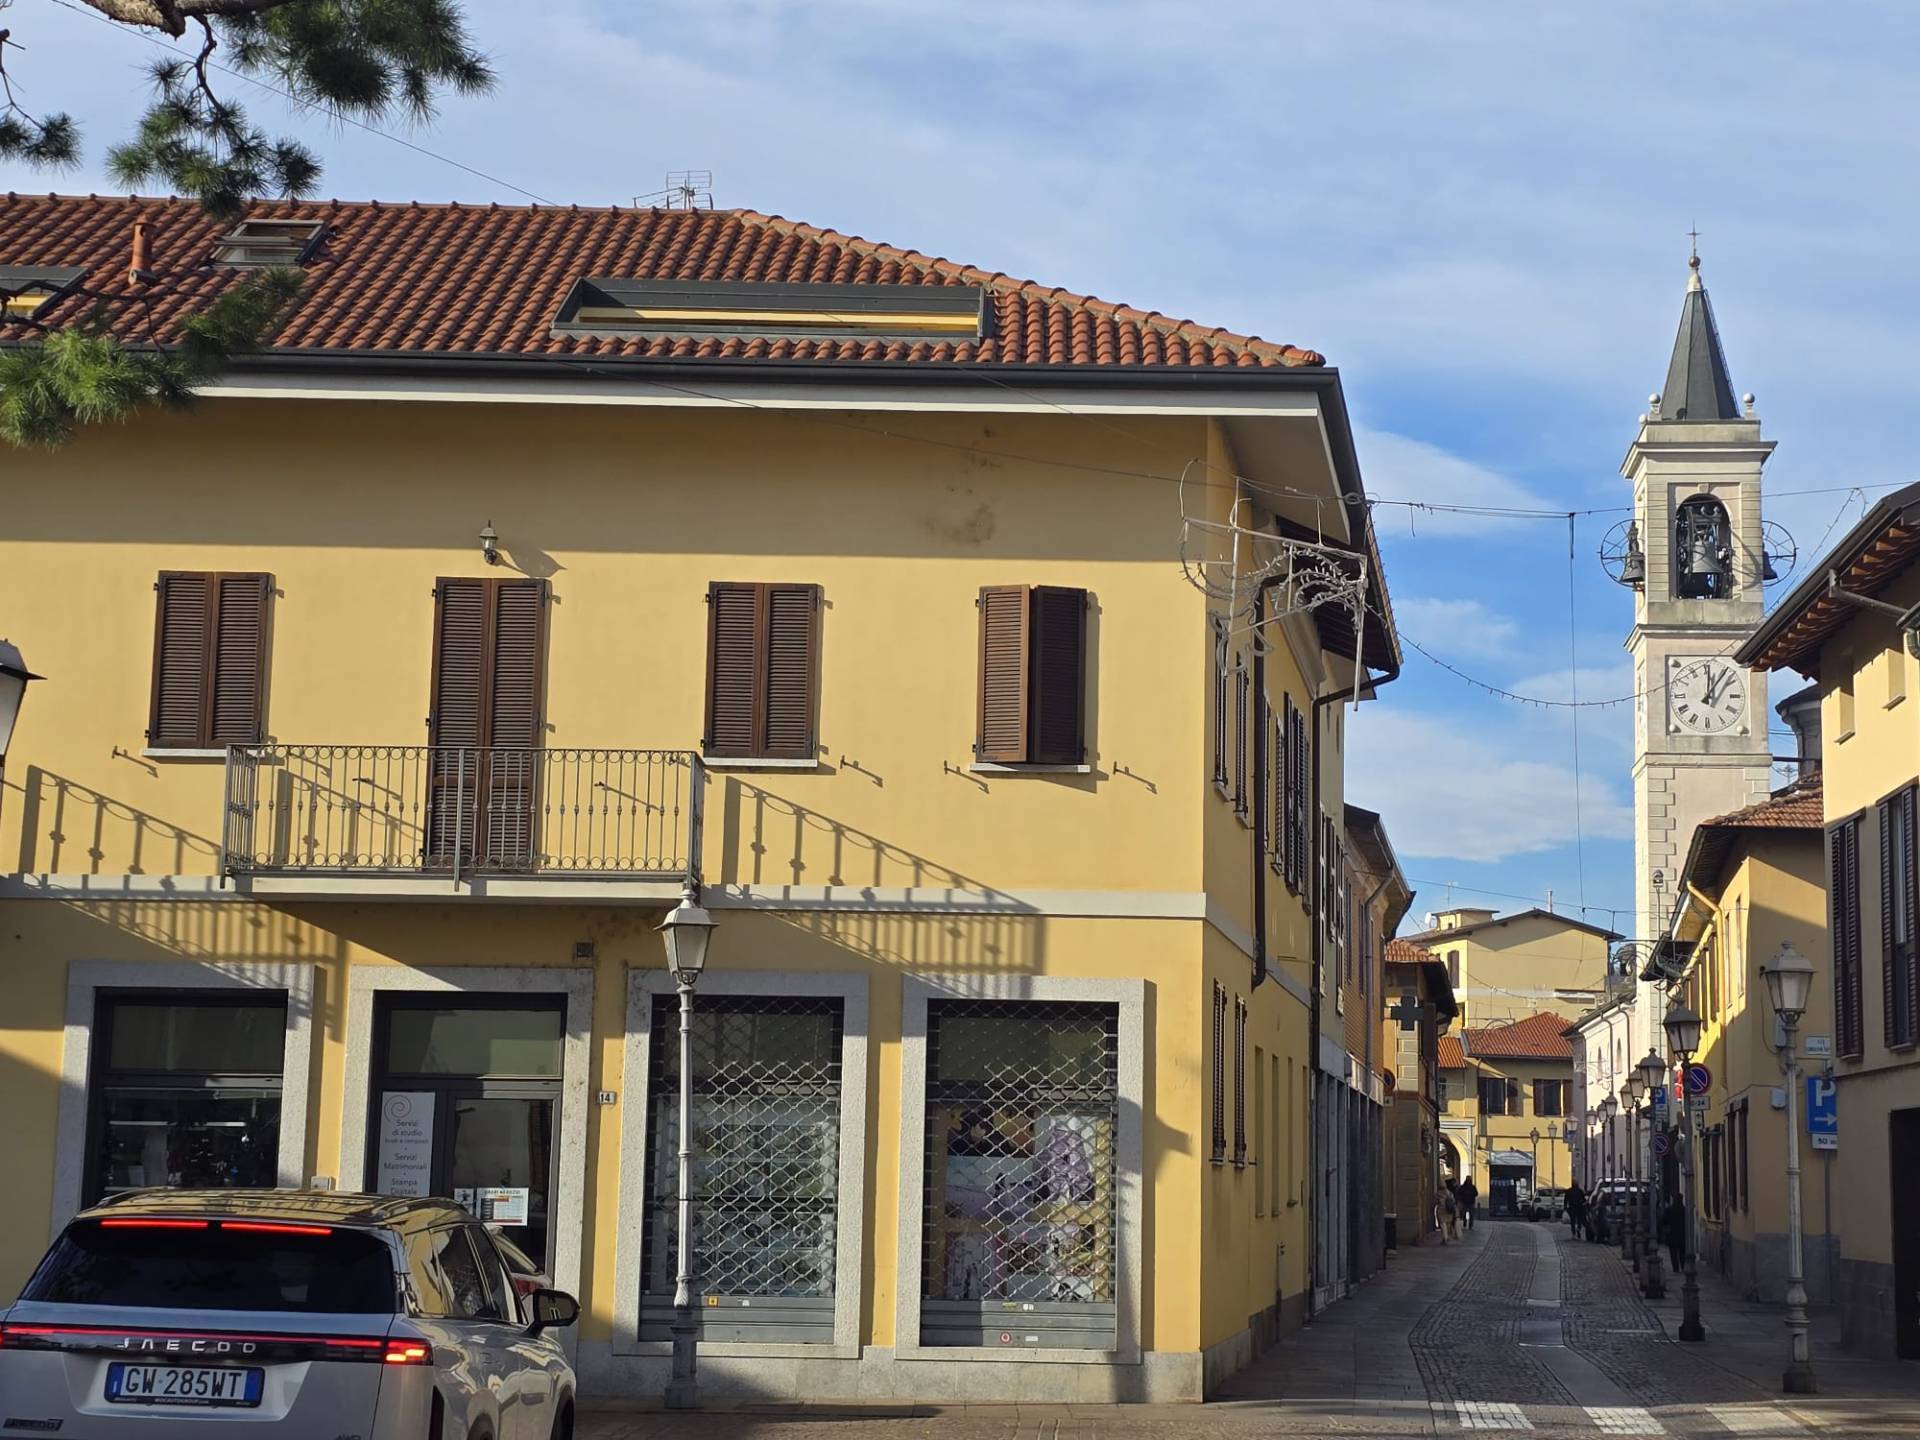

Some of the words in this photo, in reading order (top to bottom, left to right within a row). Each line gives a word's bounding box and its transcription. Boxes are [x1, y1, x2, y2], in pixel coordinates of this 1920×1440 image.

[600, 1093, 611, 1103] 14
[1815, 1080, 1836, 1107] P
[396, 1119, 418, 1127] Servizi
[392, 1128, 400, 1137] di
[401, 1128, 423, 1137] studio
[394, 1153, 417, 1161] Servizi
[117, 1338, 256, 1353] JAECOO
